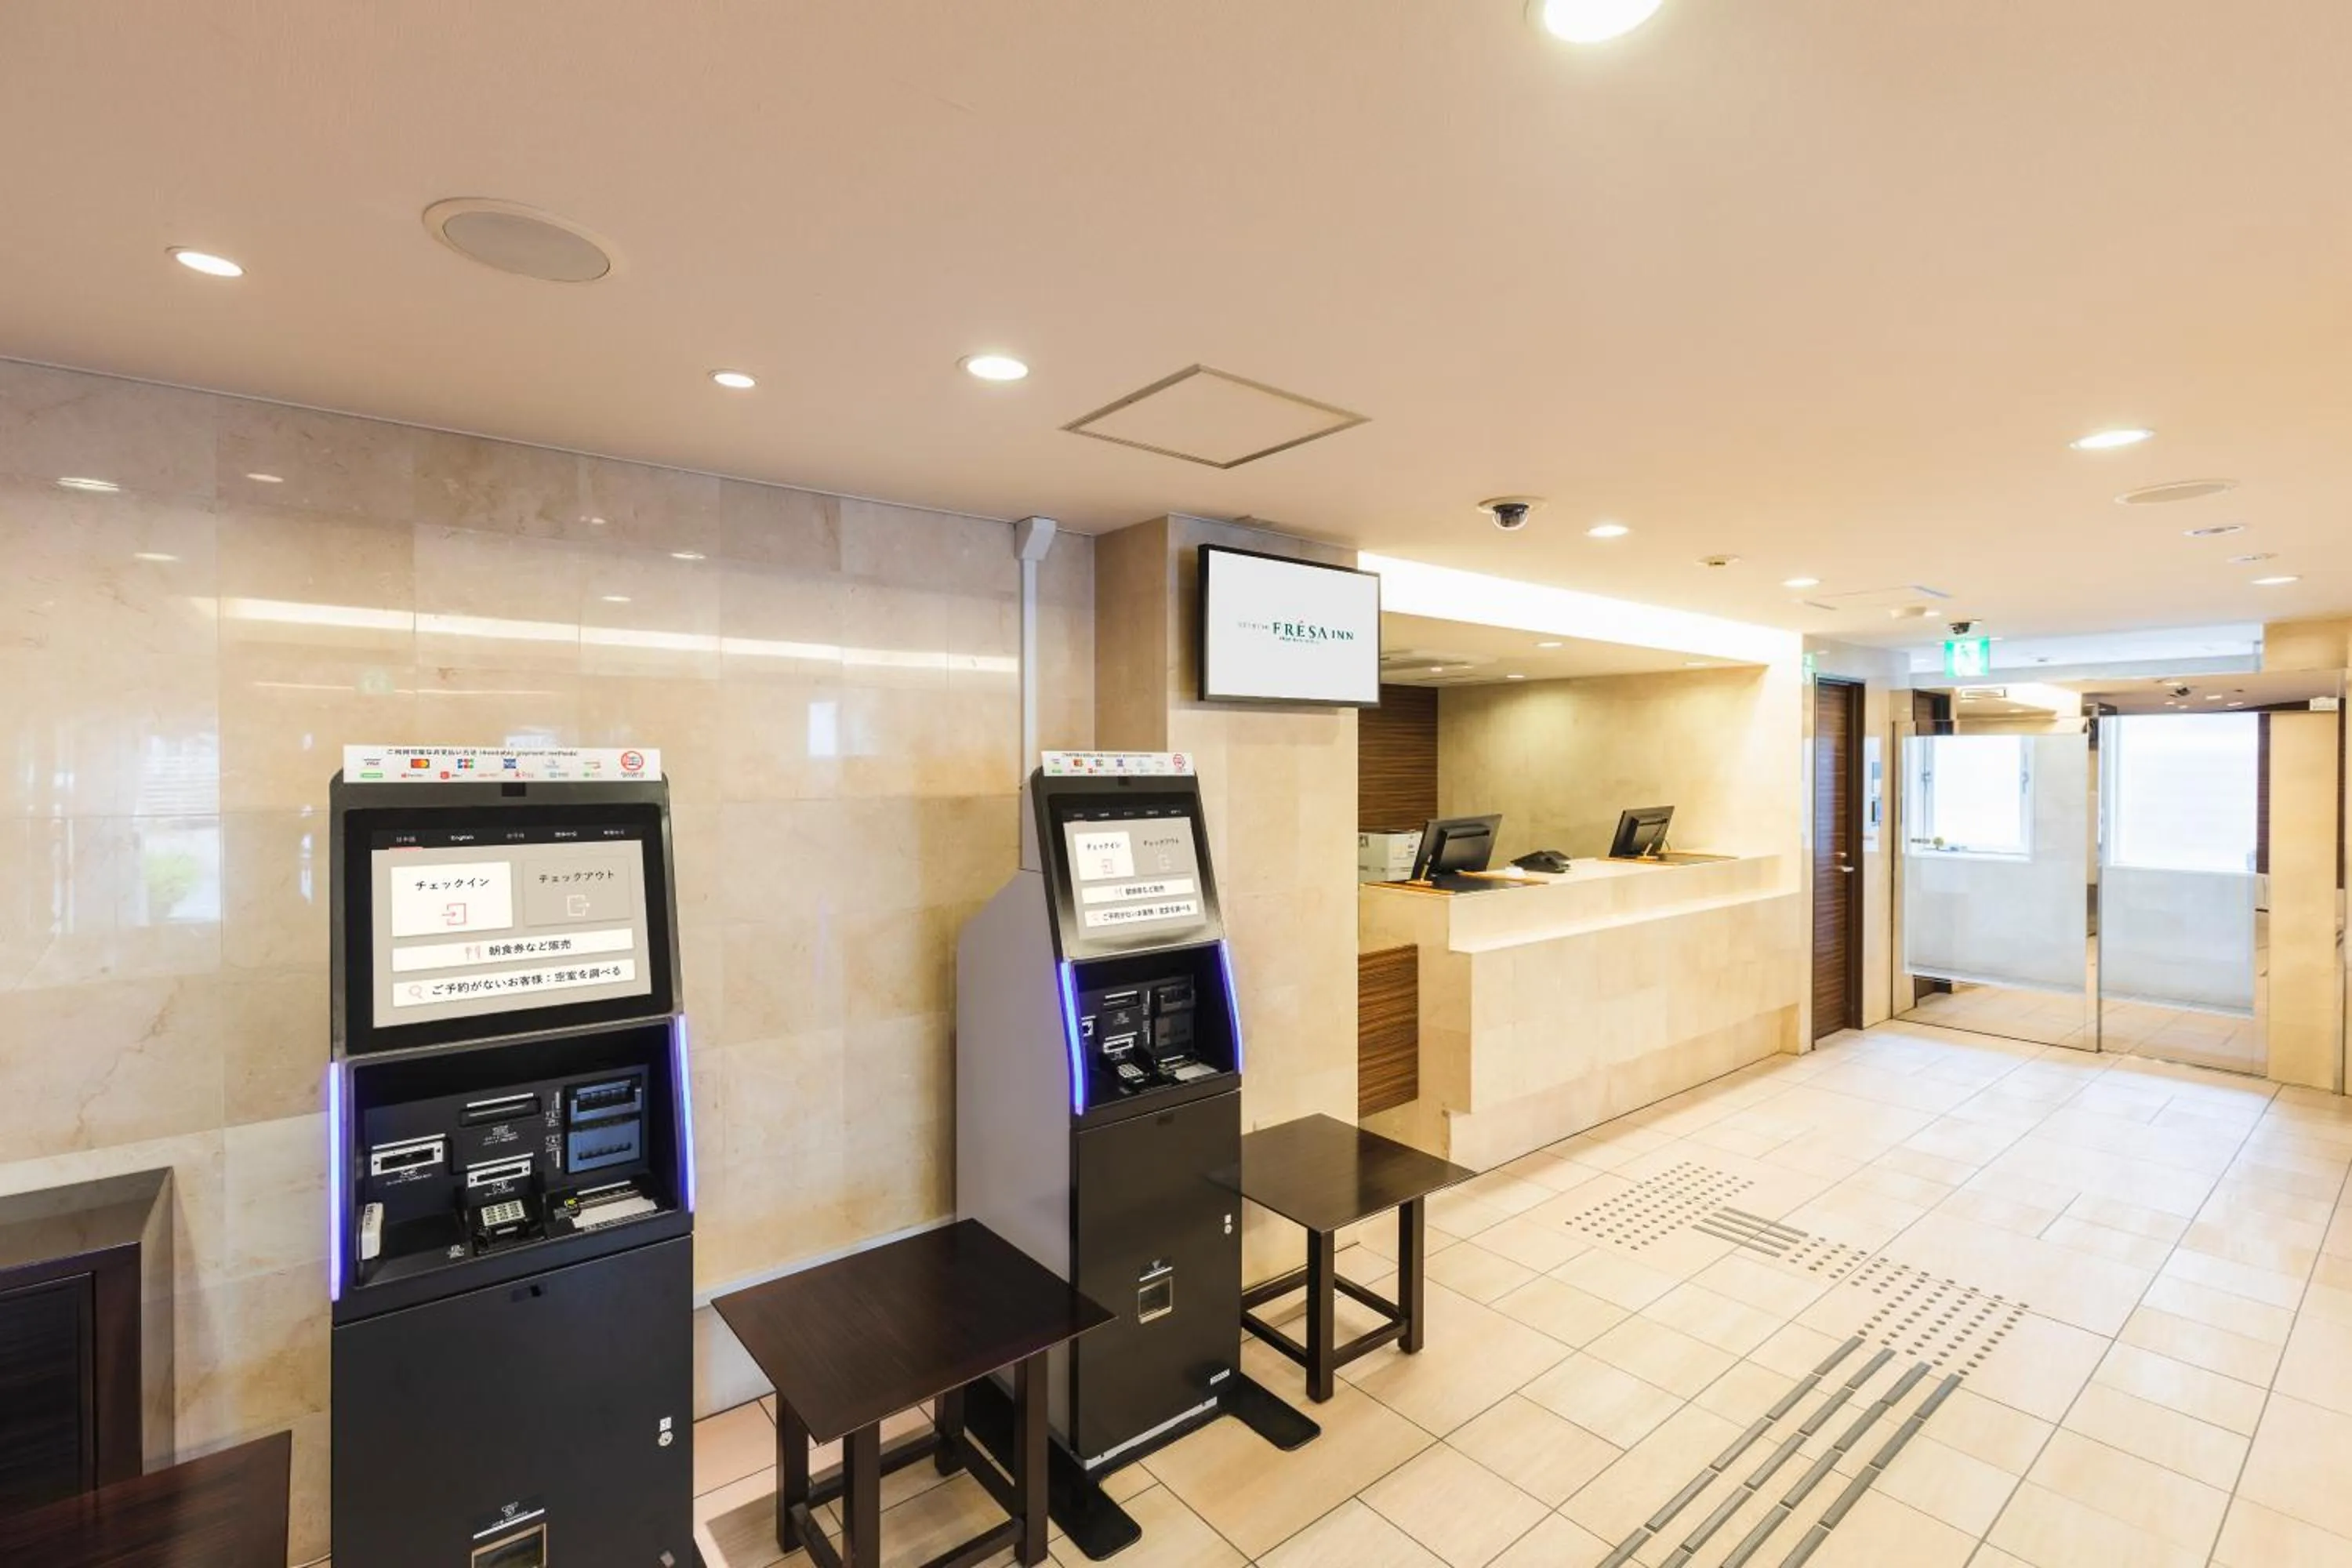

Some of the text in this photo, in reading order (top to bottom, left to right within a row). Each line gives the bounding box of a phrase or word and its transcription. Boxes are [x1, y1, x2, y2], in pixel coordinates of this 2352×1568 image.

[1272, 620, 1328, 641] FRÉSA
[1331, 630, 1355, 641] INN
[415, 878, 490, 891] チェックイン
[539, 870, 615, 884] チェックアウト
[488, 938, 572, 956] 朝食券など販売
